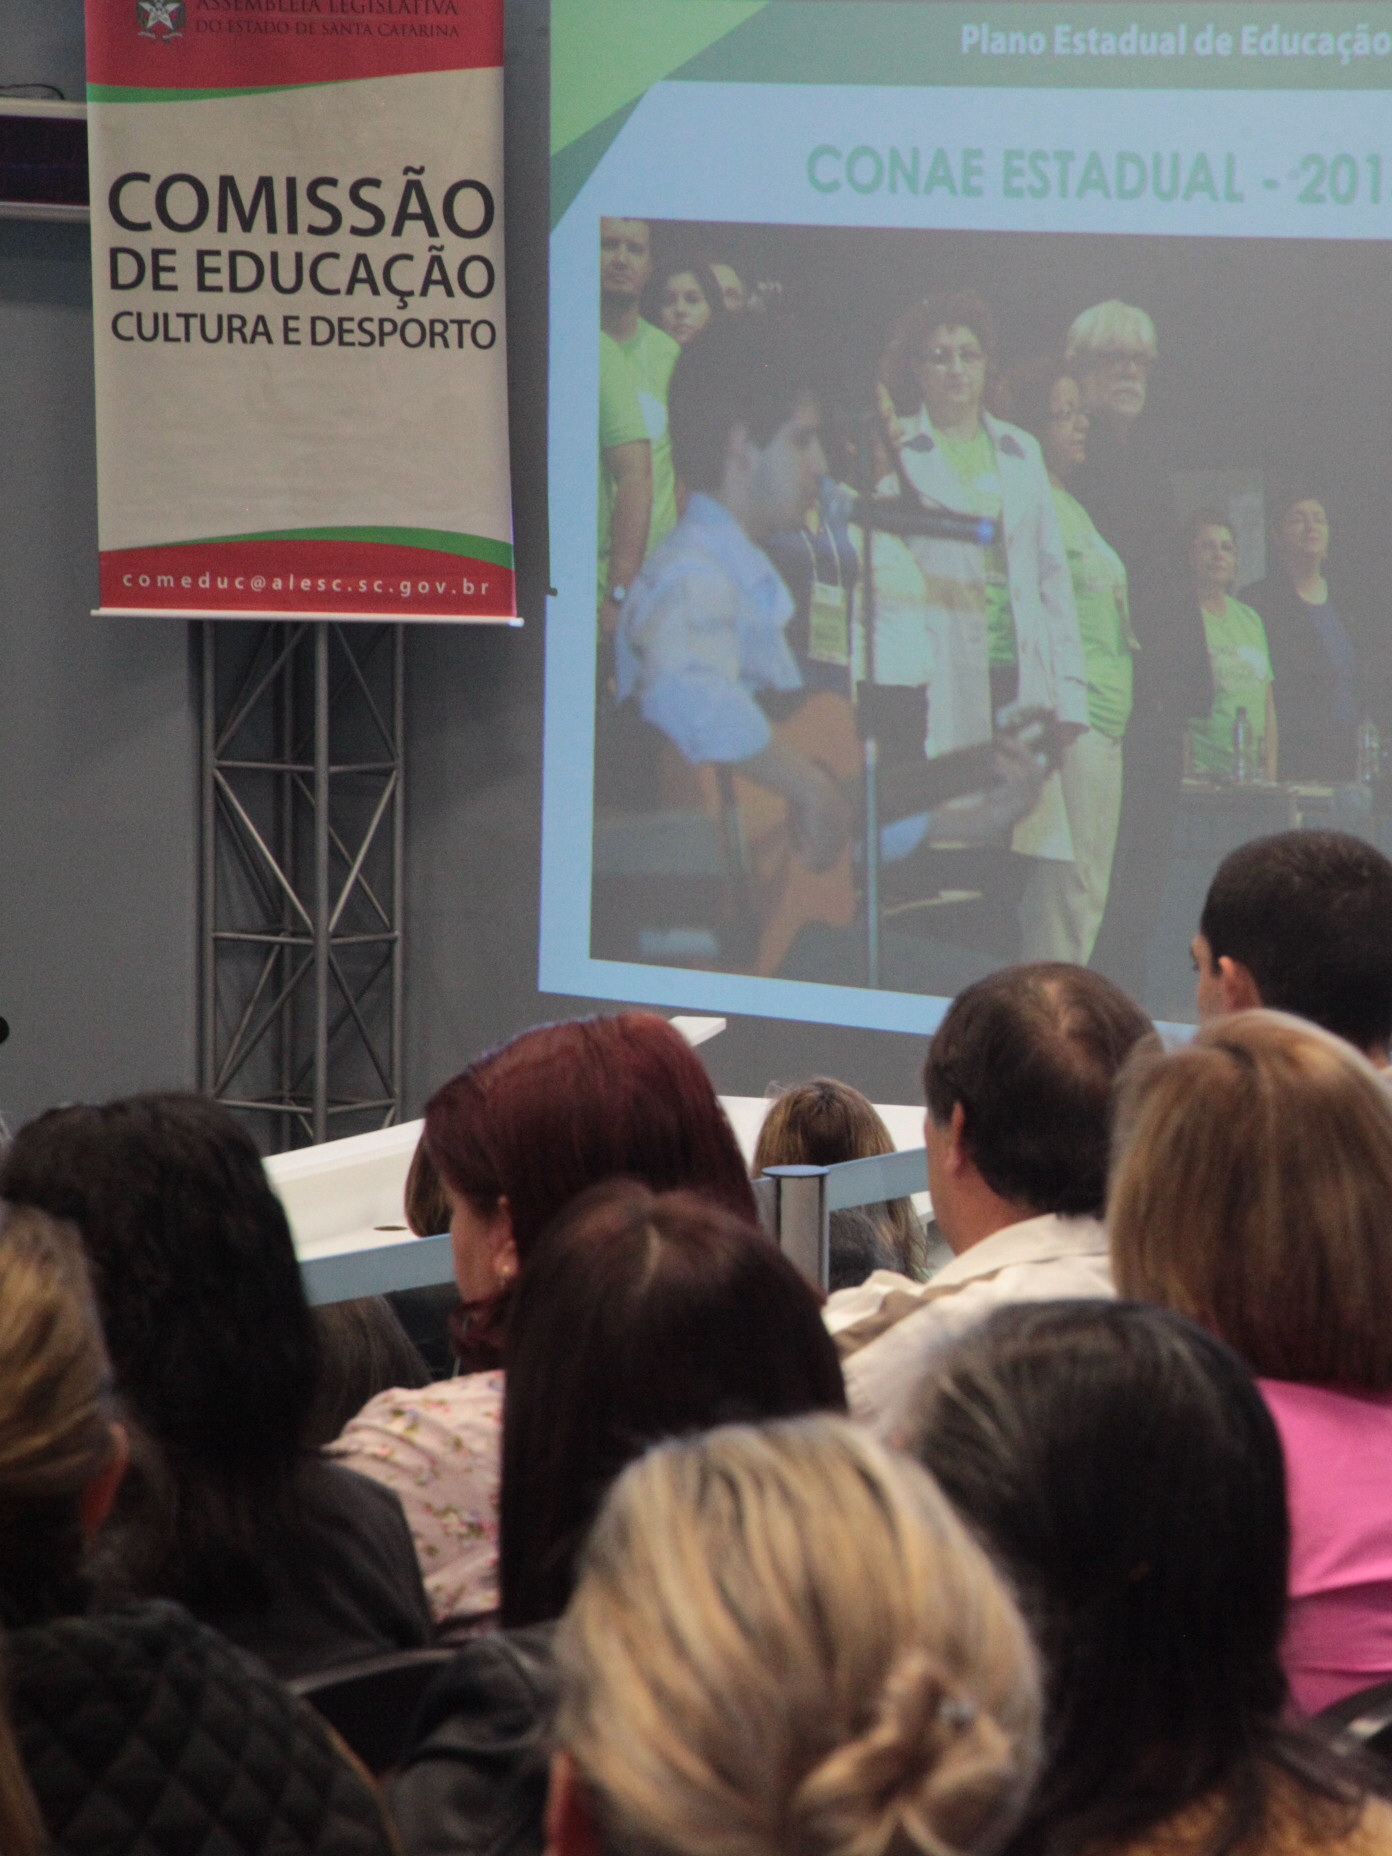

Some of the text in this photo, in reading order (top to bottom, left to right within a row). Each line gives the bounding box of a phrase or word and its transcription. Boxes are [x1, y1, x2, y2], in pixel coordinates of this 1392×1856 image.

[329, 0, 458, 15] LEGISLATIVA
[197, 20, 460, 37] DO ESTADO DE SANTA CATARINA
[961, 23, 1047, 55] Plano
[1054, 24, 1187, 55] Estadual
[1194, 24, 1234, 55] de
[806, 144, 985, 196] CONAE
[1001, 149, 1244, 202] ESTADUAL
[107, 165, 496, 239] COMISSÃO
[108, 244, 496, 310] DE EDUCAÇÃO
[110, 310, 497, 349] CULTURA E DESPORTO
[122, 571, 490, 596] comeduc@alesc.sc.gov.br
